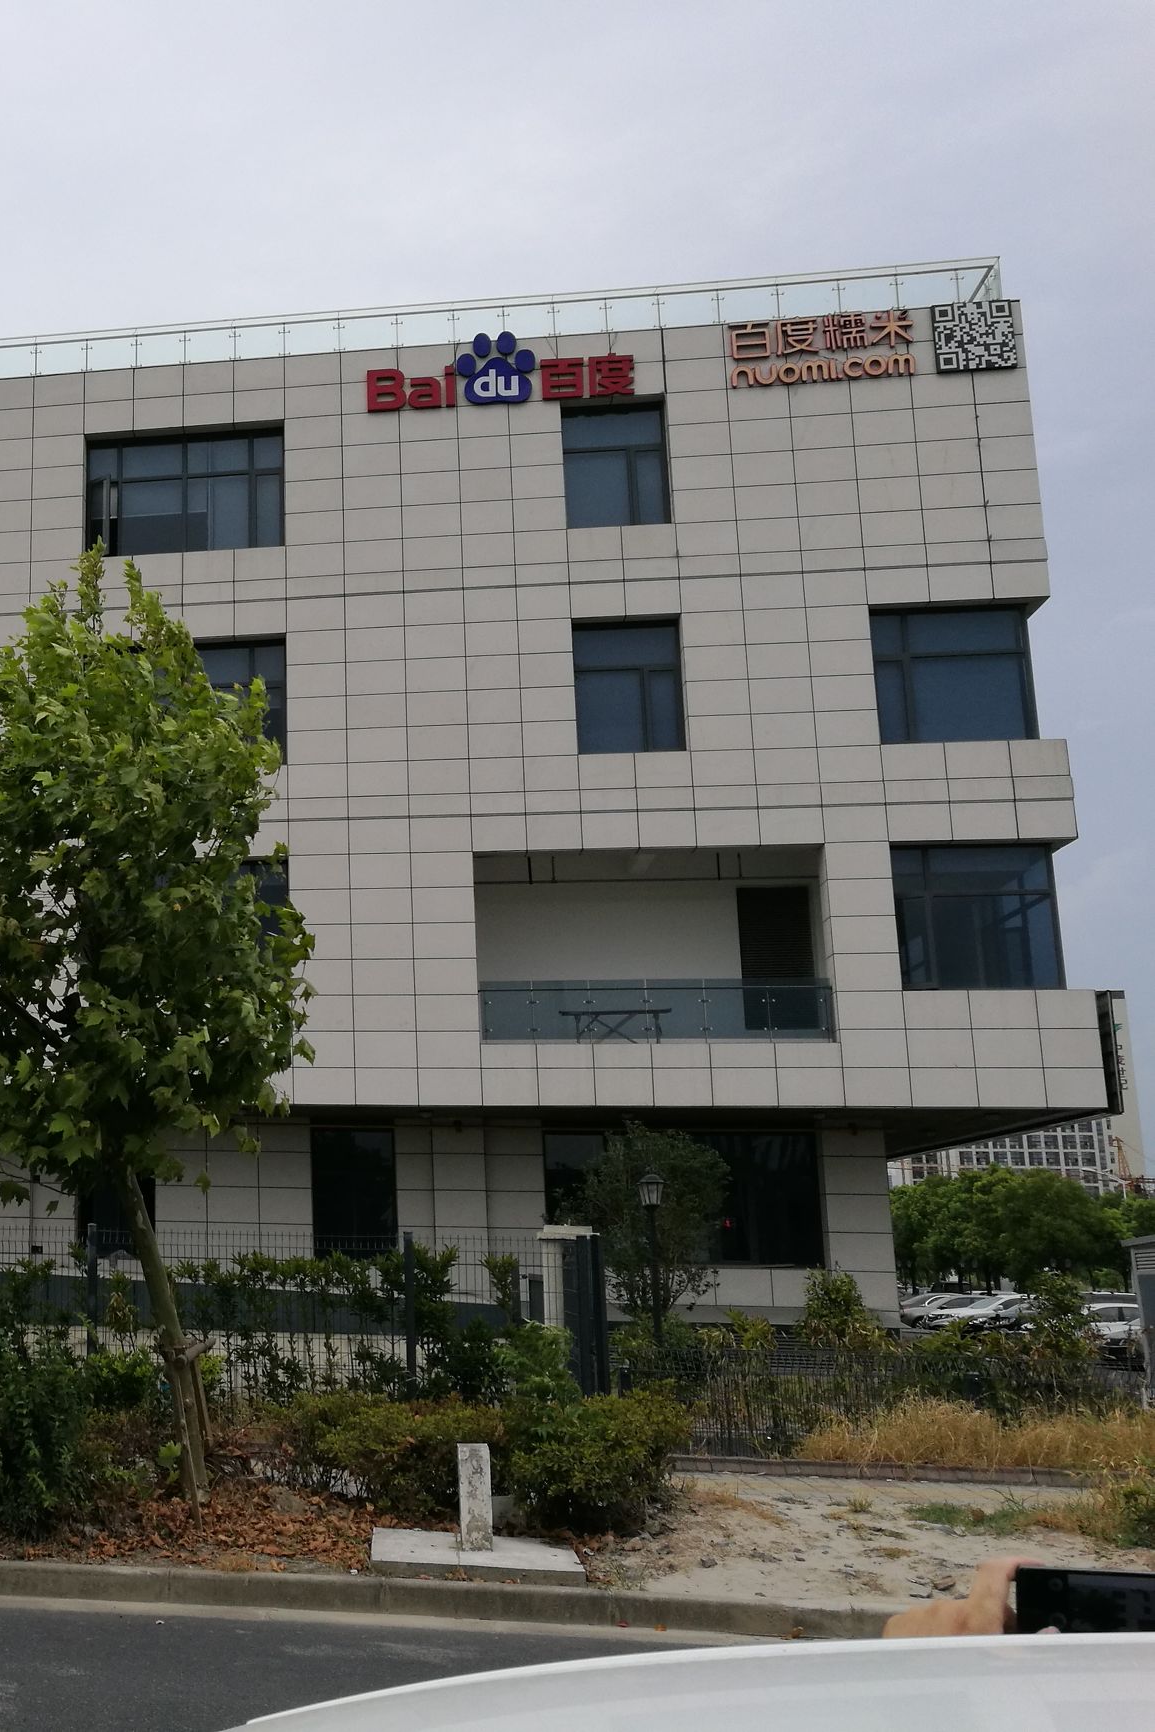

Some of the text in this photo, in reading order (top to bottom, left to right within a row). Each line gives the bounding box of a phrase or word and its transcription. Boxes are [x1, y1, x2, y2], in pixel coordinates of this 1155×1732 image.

[728, 309, 914, 360] 百度糯米
[540, 353, 635, 400] 百度
[731, 353, 916, 388] nuomi.com
